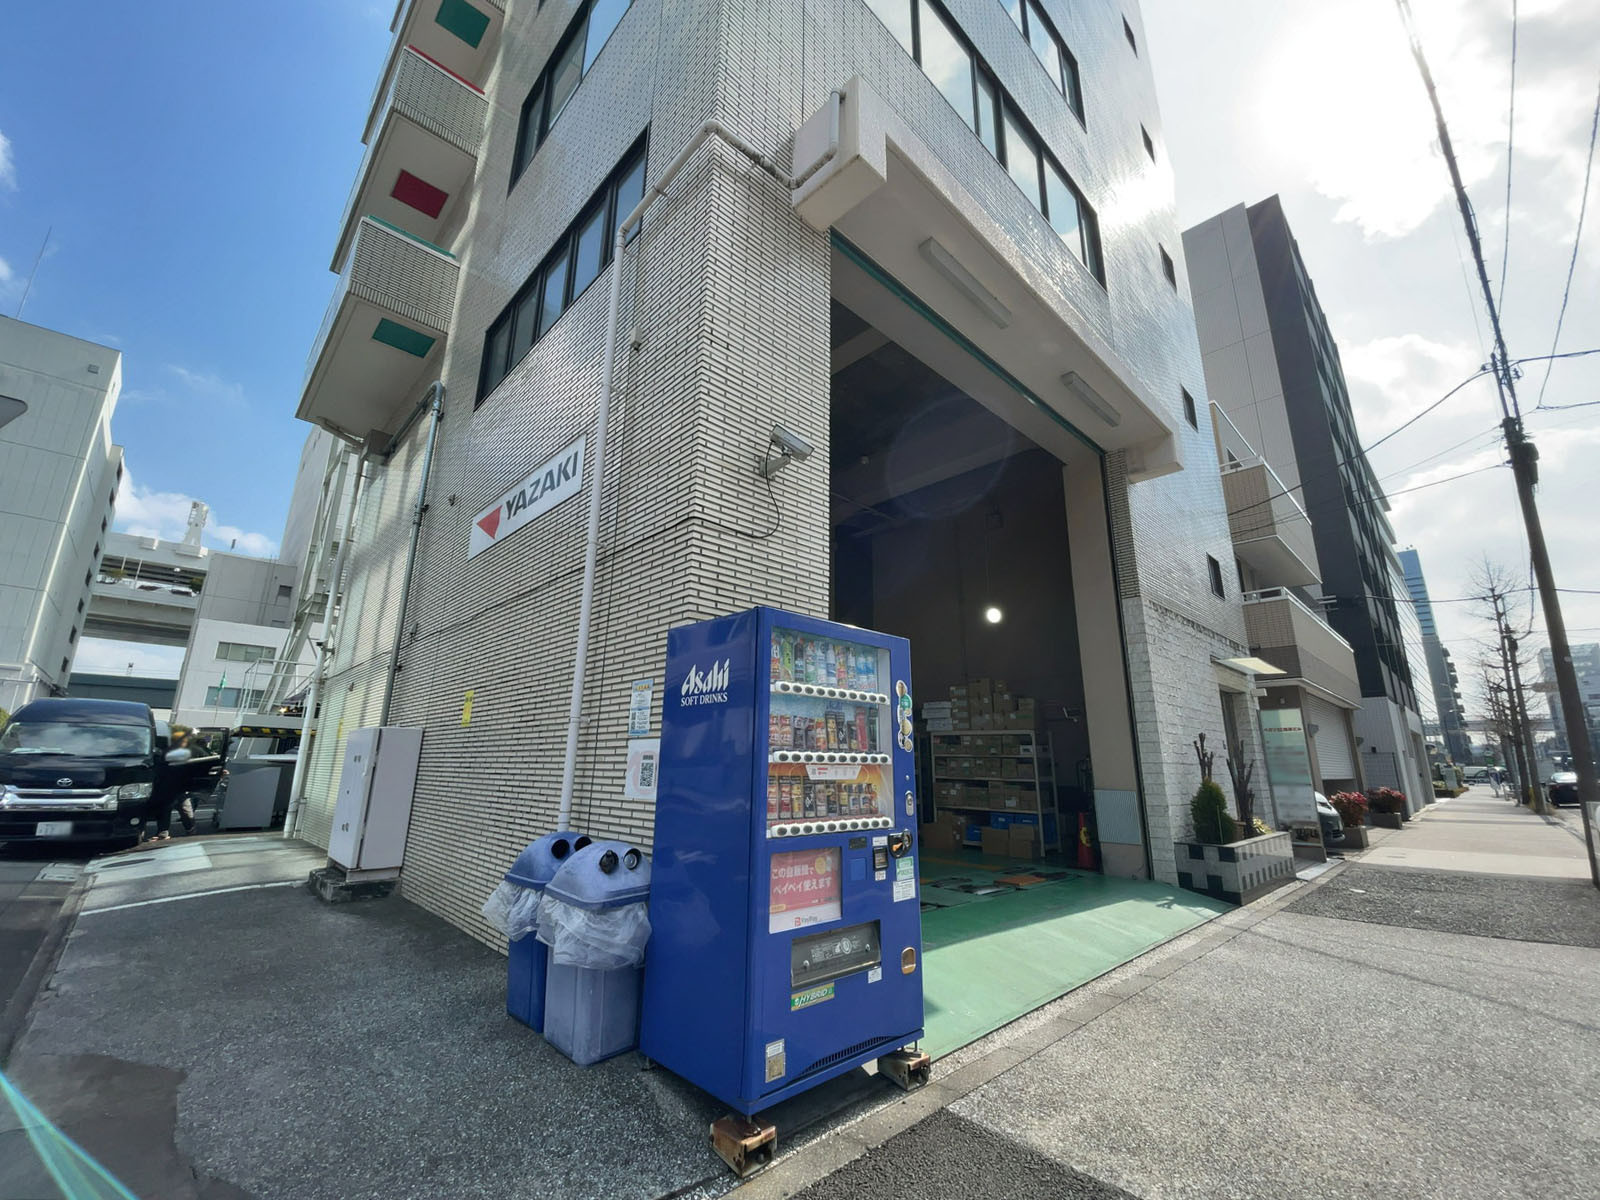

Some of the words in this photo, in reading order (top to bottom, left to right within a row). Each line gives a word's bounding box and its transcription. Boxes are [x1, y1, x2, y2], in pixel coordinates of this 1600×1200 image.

[505, 451, 579, 520] YAZAKI
[681, 658, 730, 696] Asahi
[680, 695, 698, 707] SOFT
[699, 691, 728, 705] DRINKS
[773, 877, 832, 895] ペイペイ使えます
